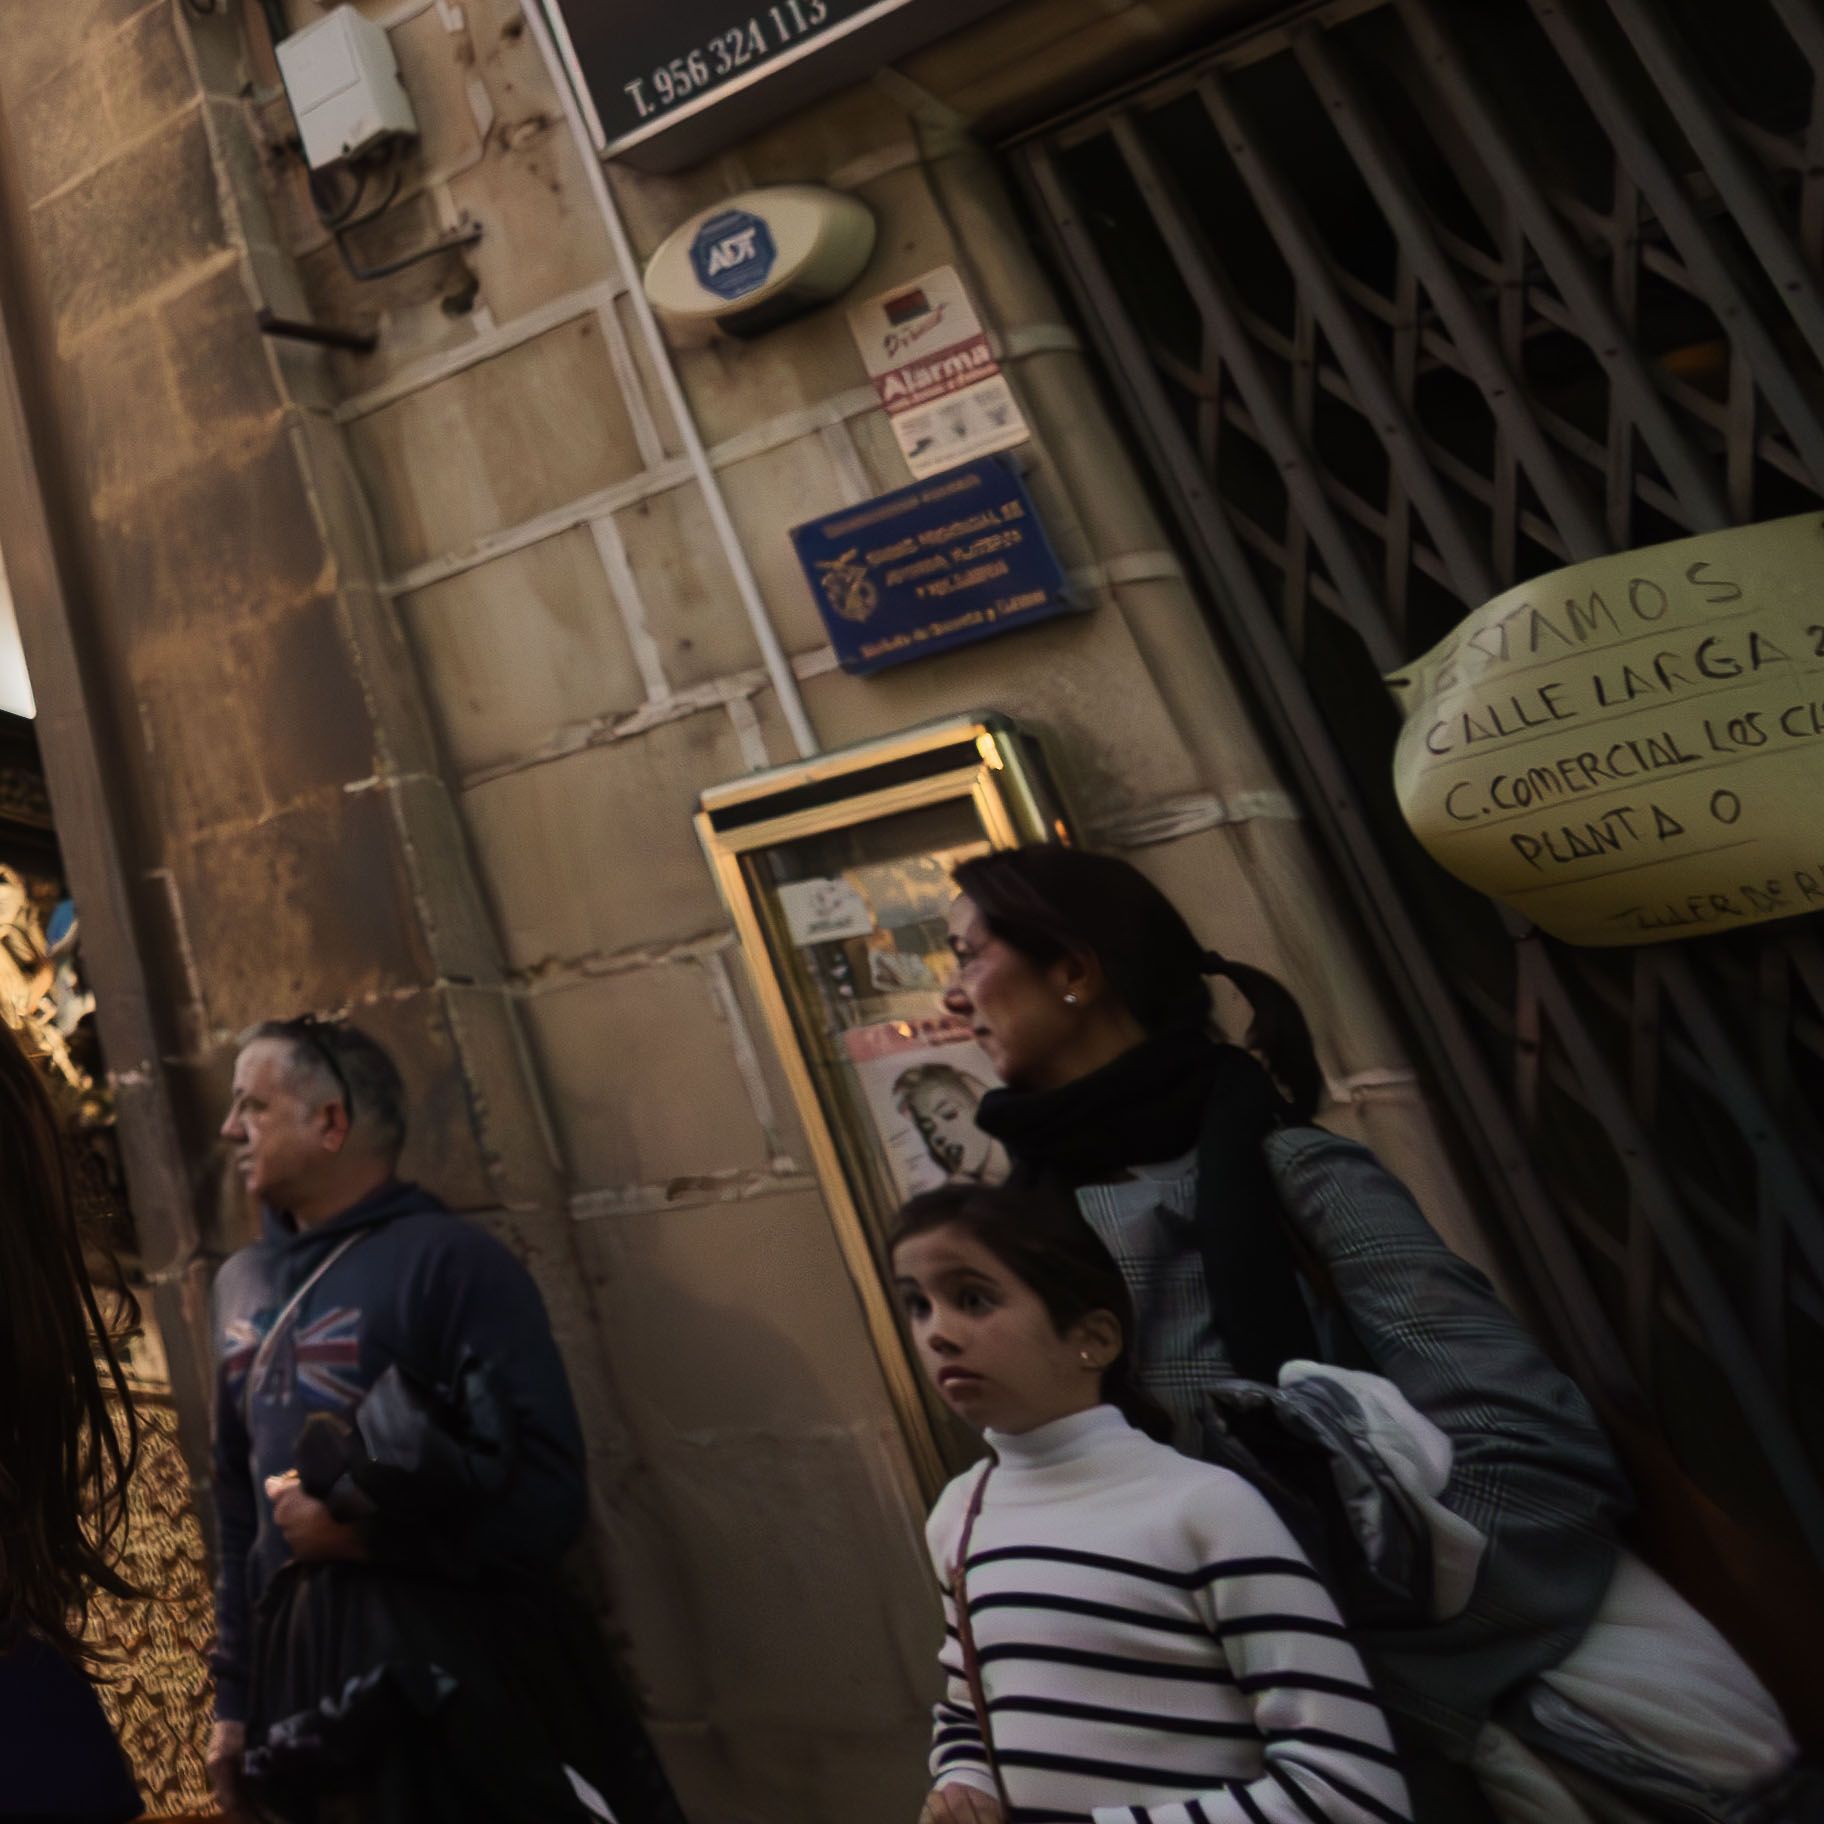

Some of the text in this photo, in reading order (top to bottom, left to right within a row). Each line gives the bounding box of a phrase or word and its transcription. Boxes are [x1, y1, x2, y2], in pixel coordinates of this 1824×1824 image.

[624, 77, 655, 118] T.
[653, 48, 710, 105] 956
[709, 17, 770, 76] 324
[706, 227, 760, 276] ADT
[882, 342, 993, 404] Alarma
[1425, 682, 1578, 756] CALLE
[1592, 631, 1793, 708] LARGA
[1703, 710, 1769, 753] LOS
[1509, 803, 1685, 871] PLANTA
